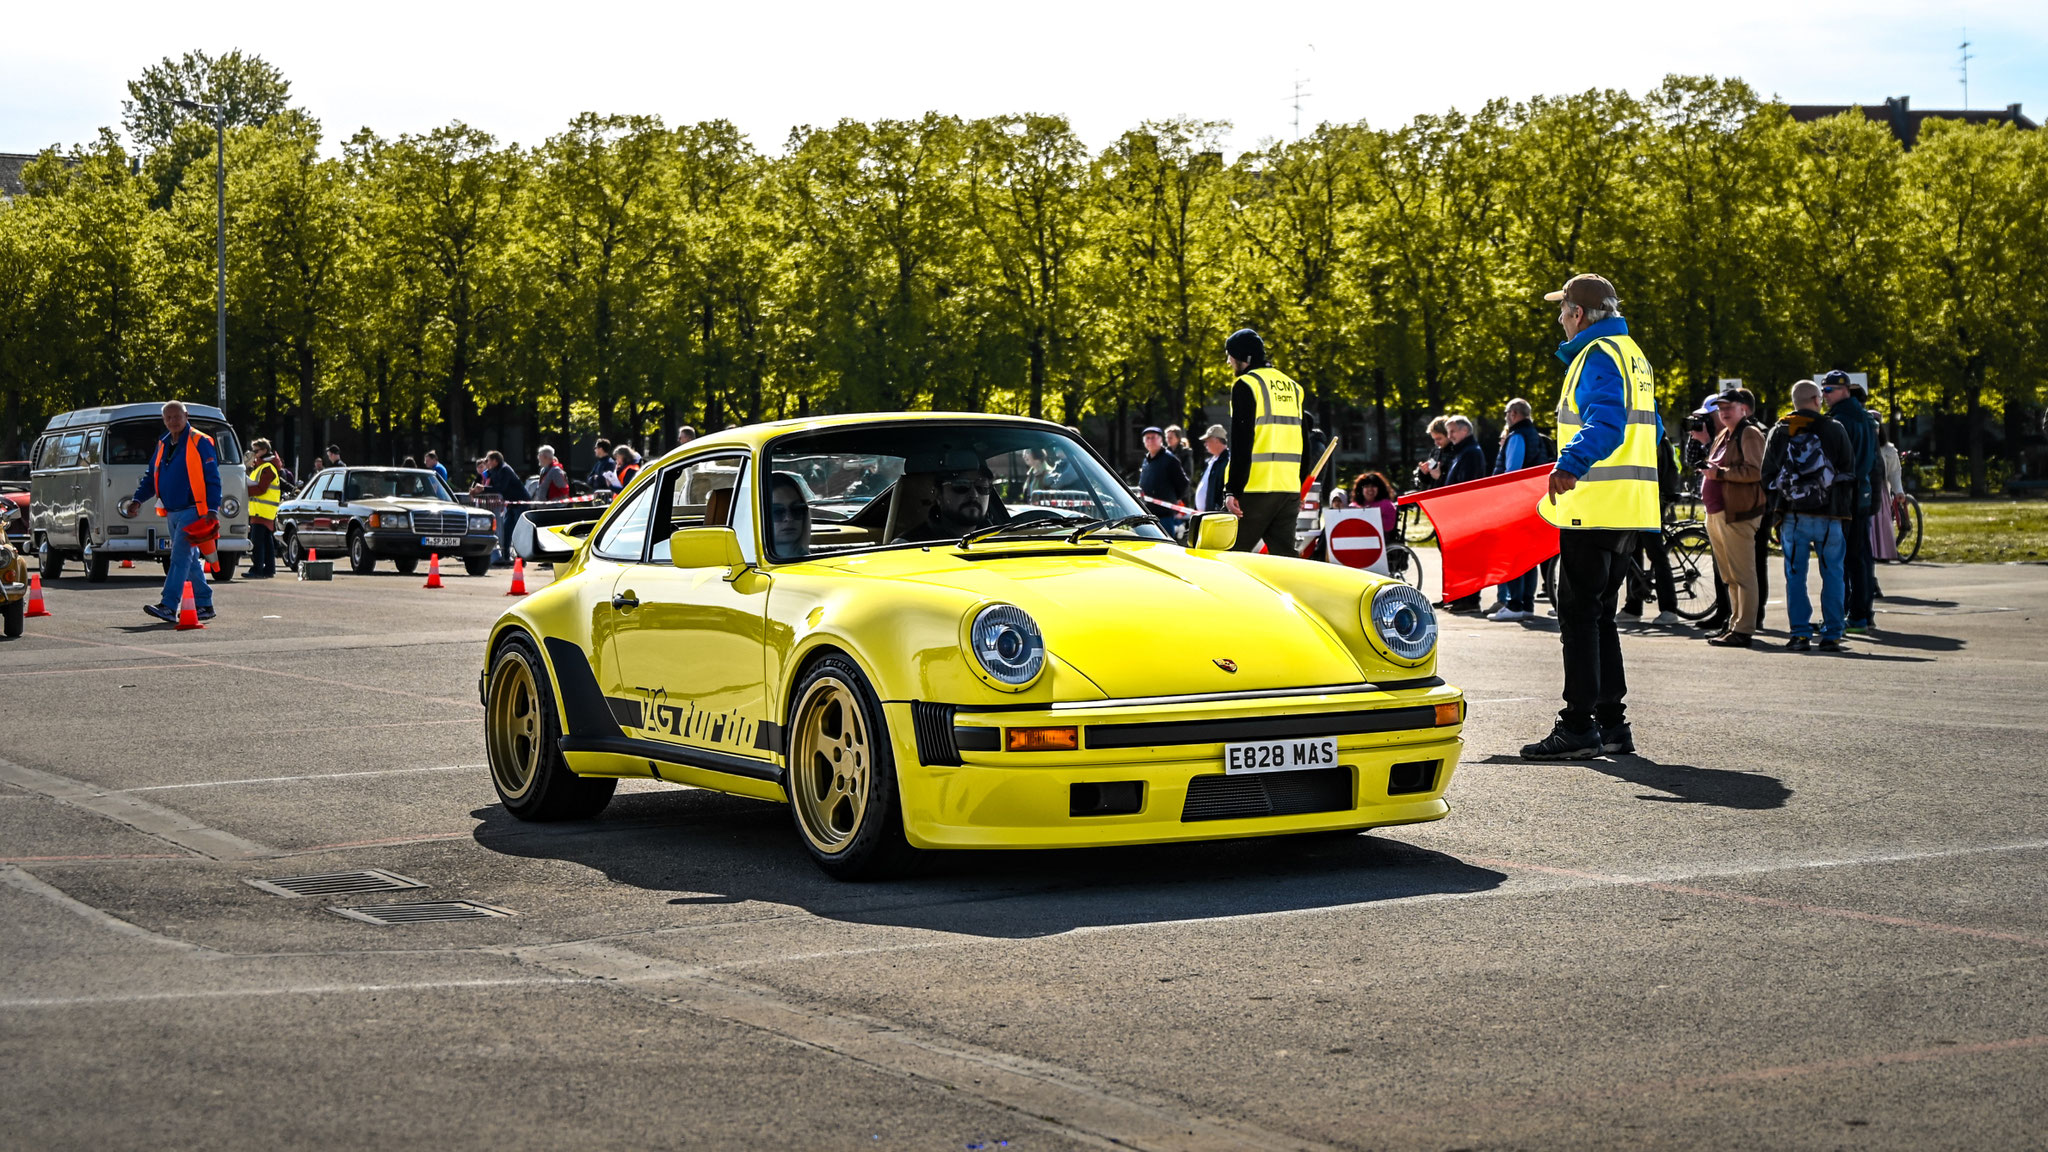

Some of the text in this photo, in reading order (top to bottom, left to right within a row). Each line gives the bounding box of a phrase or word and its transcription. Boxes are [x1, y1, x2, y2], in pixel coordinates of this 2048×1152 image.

[1270, 379, 1293, 392] ACM
[1274, 392, 1293, 402] Team
[825, 659, 857, 679] MICHELIN
[1230, 742, 1333, 769] E828 MAS
